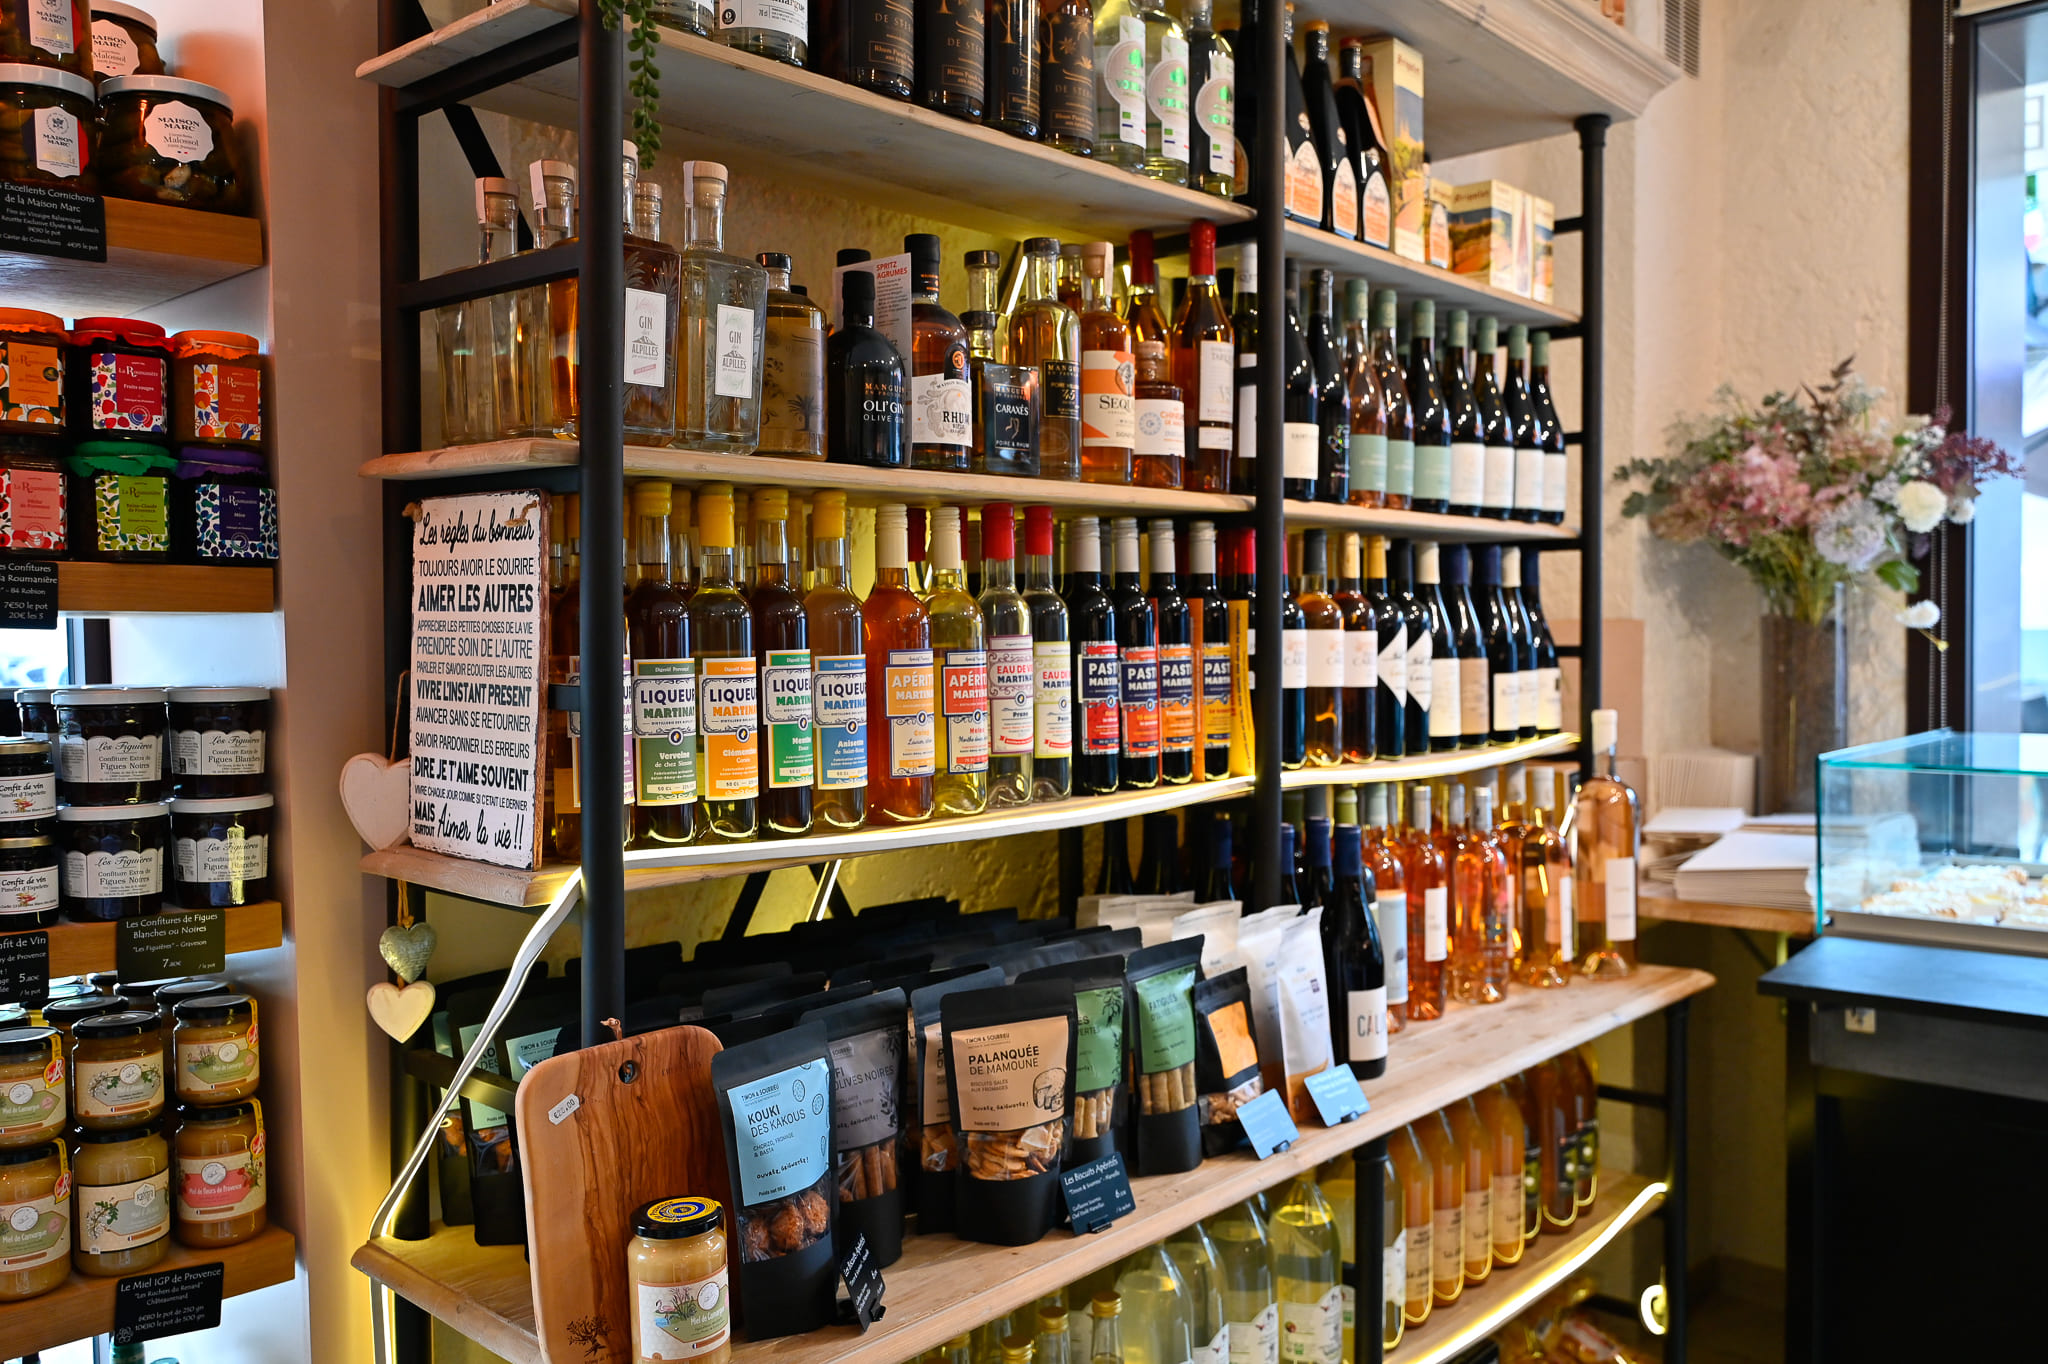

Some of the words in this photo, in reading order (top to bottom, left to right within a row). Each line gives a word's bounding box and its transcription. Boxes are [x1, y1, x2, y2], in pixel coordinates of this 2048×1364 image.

[158, 116, 200, 128] MAISON
[164, 123, 197, 132] MARC
[163, 135, 199, 147] Malossol
[4, 182, 46, 196] Excellents
[47, 189, 96, 203] Cornichons
[4, 194, 16, 203] de
[27, 198, 58, 210] Maison
[60, 202, 81, 212] Marc
[876, 261, 897, 272] SPRITZ
[877, 267, 908, 280] AGRUMES
[638, 315, 653, 330] GIN
[728, 330, 742, 344] GIN
[631, 343, 659, 357] ALPILLES
[722, 357, 747, 370] ALPILLES
[863, 414, 892, 423] OLIVE
[942, 410, 970, 425] RHUM
[420, 512, 438, 545] Les
[440, 510, 469, 554] règles
[472, 509, 487, 542] du
[488, 507, 534, 543] bonheur
[8, 562, 52, 573] Confitures
[419, 559, 459, 577] TOUJOURS
[459, 558, 484, 576] AVOIR
[485, 558, 495, 576] LE
[496, 557, 534, 576] SOURIRE
[8, 574, 58, 584] Roumanière
[418, 584, 456, 612] AIMER
[458, 584, 481, 612] LES
[483, 583, 534, 612] AUTRES
[35, 603, 48, 611] pot
[417, 620, 447, 632] APPRECIER
[447, 620, 458, 633] LES
[458, 621, 481, 633] PETITES
[481, 621, 504, 634] CHOSES
[506, 622, 514, 634] DE
[514, 622, 523, 634] LA
[523, 622, 533, 634] VIE
[417, 636, 456, 656] PRENDRE
[458, 637, 479, 657] SOIN
[480, 638, 493, 658] DE
[495, 639, 532, 660] L'AUTRE
[416, 660, 438, 674] PARLER
[438, 662, 446, 675] ET
[446, 662, 466, 676] SAVOIR
[467, 663, 495, 678] ECOUTER
[496, 664, 507, 678] LES
[507, 665, 532, 680] AUTRES
[997, 665, 1016, 674] EAU
[1016, 664, 1026, 673] DE
[1042, 671, 1060, 680] EAU
[416, 679, 442, 700] VIVRE
[443, 681, 487, 705] L'INSTANT
[488, 684, 532, 707] PRESENT
[416, 706, 448, 724] AVANCER
[449, 709, 468, 727] SANS
[470, 711, 480, 728] SE
[482, 712, 530, 733] RETOURNER
[415, 732, 438, 748] SAVOIR
[439, 734, 479, 753] PARDONNER
[480, 739, 494, 755] LES
[494, 740, 530, 759] ERREURS
[208, 756, 232, 764] Figues
[659, 751, 690, 760] Verveine
[100, 762, 127, 772] Figues
[129, 762, 150, 770] Noires
[414, 756, 435, 779] DIRE
[436, 758, 447, 781] JE
[449, 760, 479, 785] T'AIME
[481, 764, 529, 792] SOUVENT
[415, 785, 428, 795] VIVRE
[428, 786, 446, 799] CHAQUE
[446, 788, 458, 800] JOUR
[458, 790, 476, 803] COMME
[476, 792, 481, 803] SI
[499, 797, 506, 808] LE
[506, 798, 527, 812] DERNIER
[414, 800, 435, 822] MAIS
[437, 802, 471, 842] Aimer
[476, 808, 489, 845] la
[414, 823, 435, 836] SURTOUT
[203, 862, 228, 872] Figues
[1, 876, 24, 886] Confit
[99, 877, 126, 887] Figues
[129, 876, 150, 884] Noires
[126, 921, 139, 929] Les
[140, 916, 181, 927] Confitures
[182, 915, 192, 924] de
[194, 914, 218, 924] Figues
[133, 928, 167, 940] Blanches
[181, 926, 207, 934] Noires
[16, 938, 28, 948] de
[30, 936, 46, 945] Vin
[968, 1044, 1040, 1065] PALANQUÉE
[864, 1064, 894, 1081] NOIRES
[969, 1065, 984, 1076] DE
[986, 1058, 1039, 1075] MAMOUNE
[748, 1104, 781, 1126] KOUKI
[750, 1122, 769, 1138] DES
[770, 1108, 806, 1131] KAKOUS
[1064, 1176, 1074, 1186] Les
[1074, 1168, 1096, 1182] Biscuits
[121, 1284, 131, 1292] Le
[132, 1278, 152, 1290] Miel
[154, 1276, 170, 1287] IGP
[171, 1274, 182, 1284] de
[184, 1268, 222, 1280] Provence
